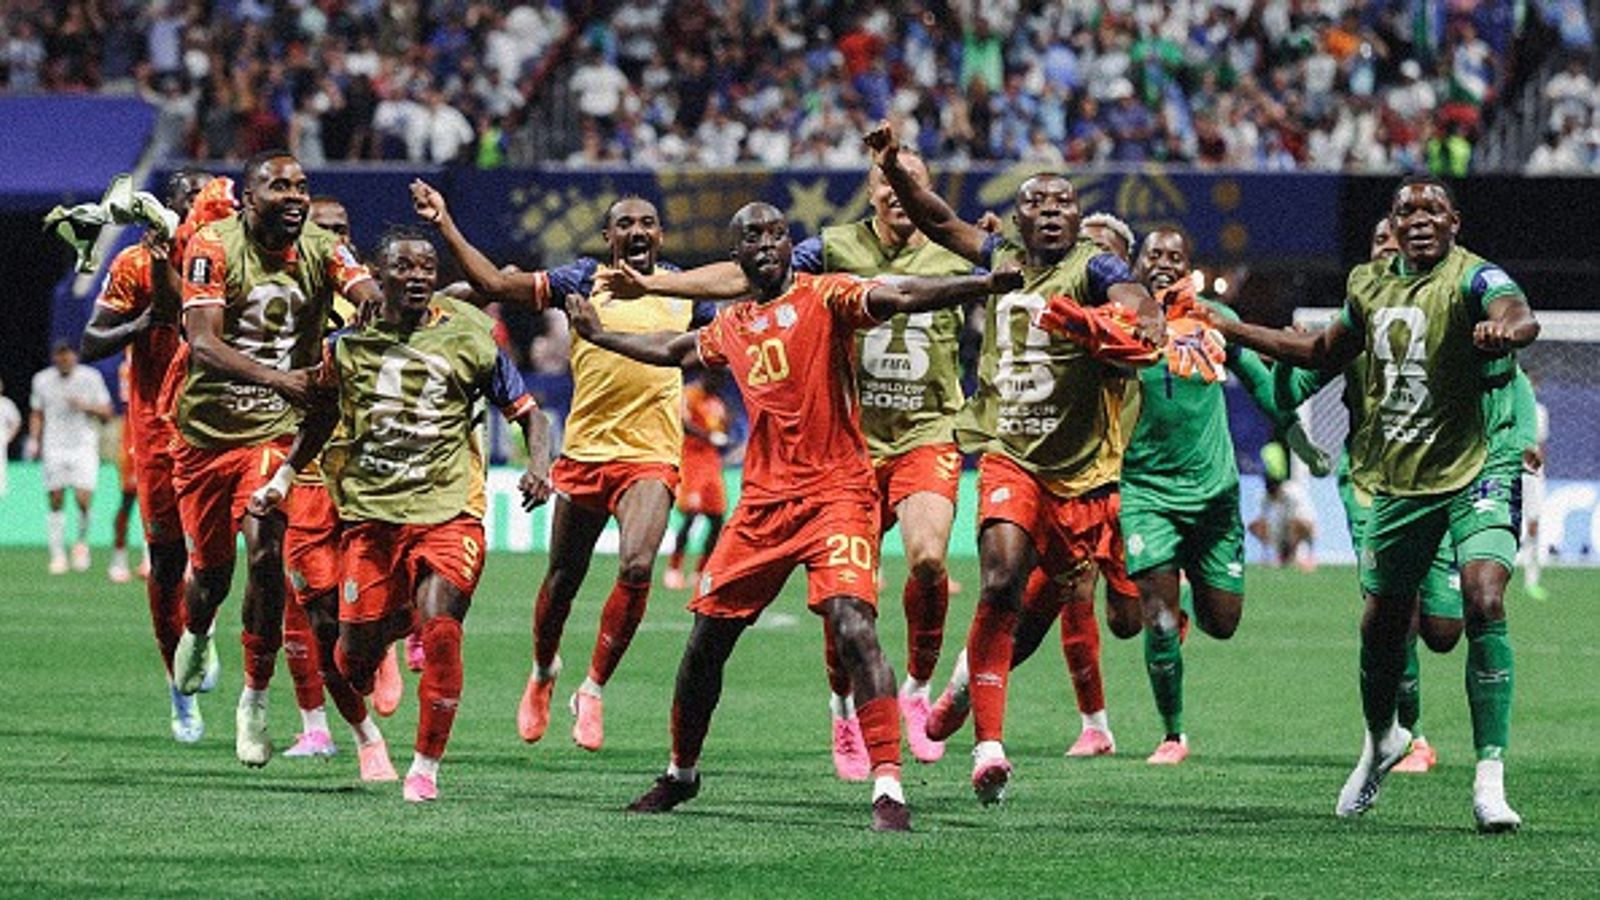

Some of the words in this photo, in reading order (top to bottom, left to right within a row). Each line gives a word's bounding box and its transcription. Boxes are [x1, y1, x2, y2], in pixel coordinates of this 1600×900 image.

[745, 339, 790, 386] 20
[881, 358, 911, 370] FIFA
[861, 391, 924, 410] 2026
[997, 418, 1058, 434] 2026
[826, 534, 871, 570] 20
